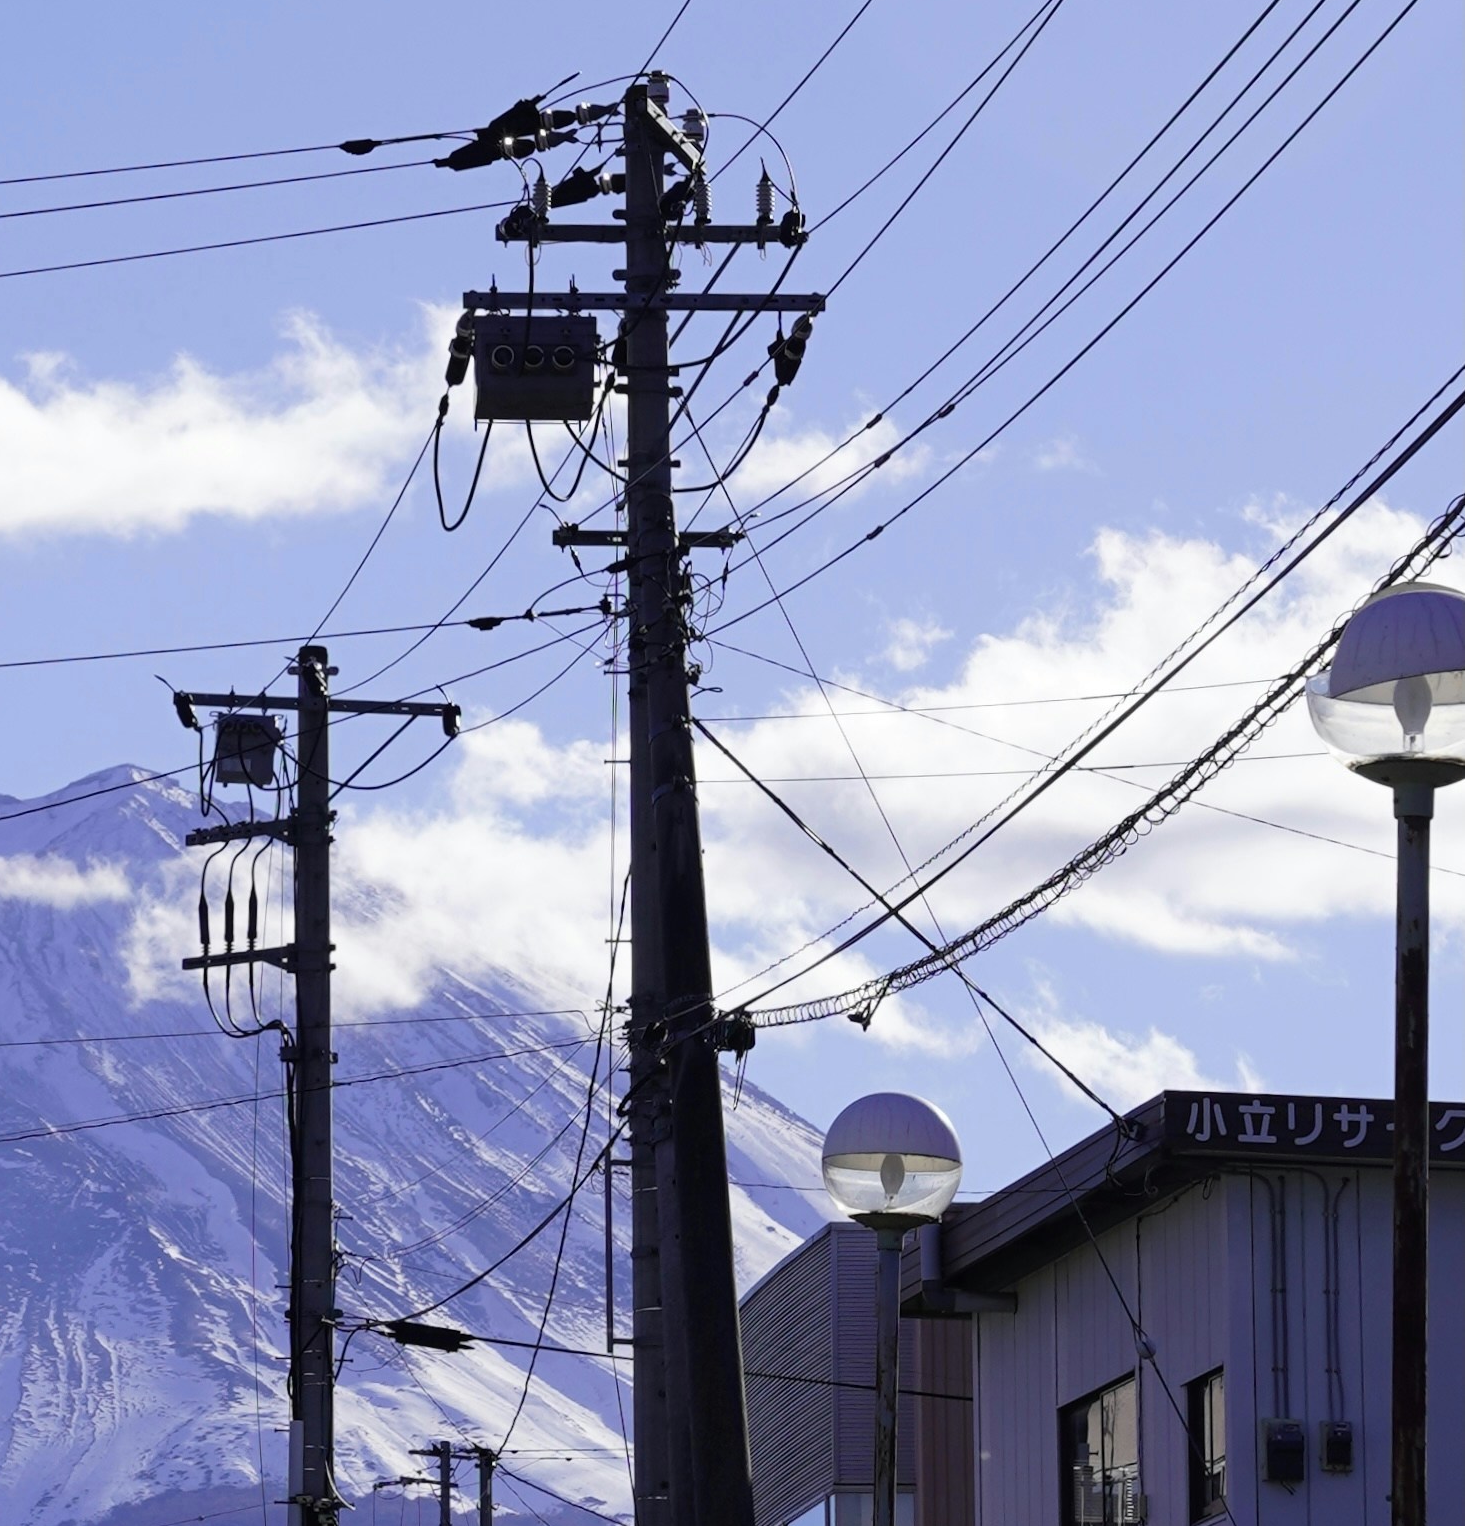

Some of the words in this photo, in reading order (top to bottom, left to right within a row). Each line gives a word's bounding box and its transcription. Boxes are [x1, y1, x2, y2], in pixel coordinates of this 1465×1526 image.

[1185, 1097, 1465, 1151] 小立リサク
